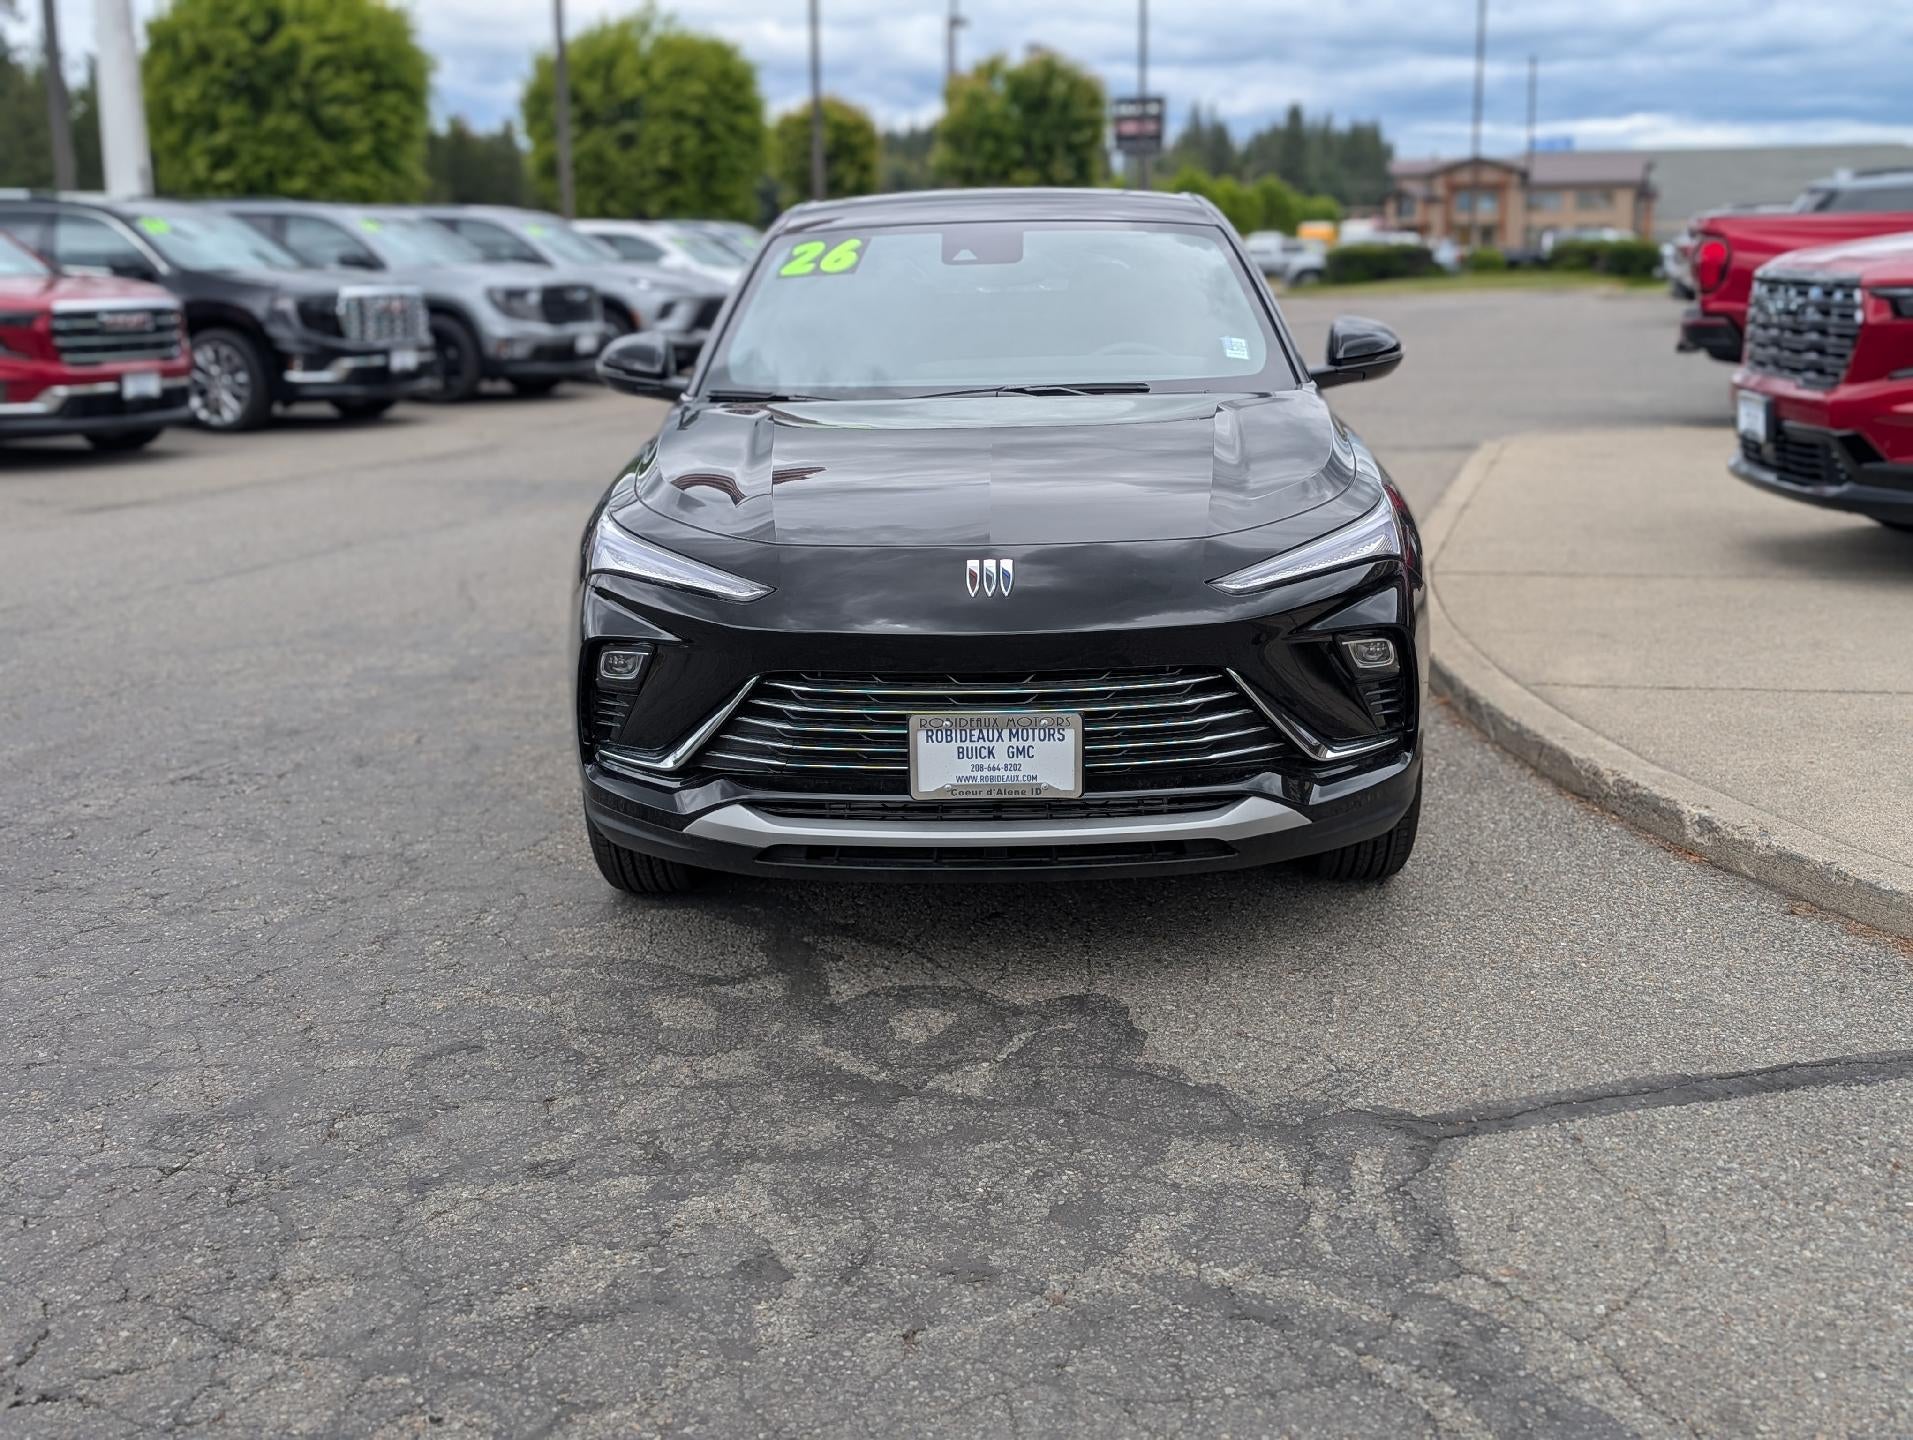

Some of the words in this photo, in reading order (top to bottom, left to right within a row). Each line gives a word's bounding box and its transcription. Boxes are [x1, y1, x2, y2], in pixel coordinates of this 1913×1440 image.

[779, 238, 863, 277] 26
[919, 717, 999, 728] ROBIDEAUX
[1006, 716, 1071, 727] MOTORS
[925, 728, 1004, 743] ROBIDEAUX
[1008, 727, 1066, 742] MOTORS
[957, 745, 995, 760] BUICK
[1007, 745, 1035, 759] GMC
[970, 763, 1022, 772] 208-664-8202
[956, 774, 1038, 783] WWW.ROBIDEAUX.COM
[951, 788, 982, 797] Coeur
